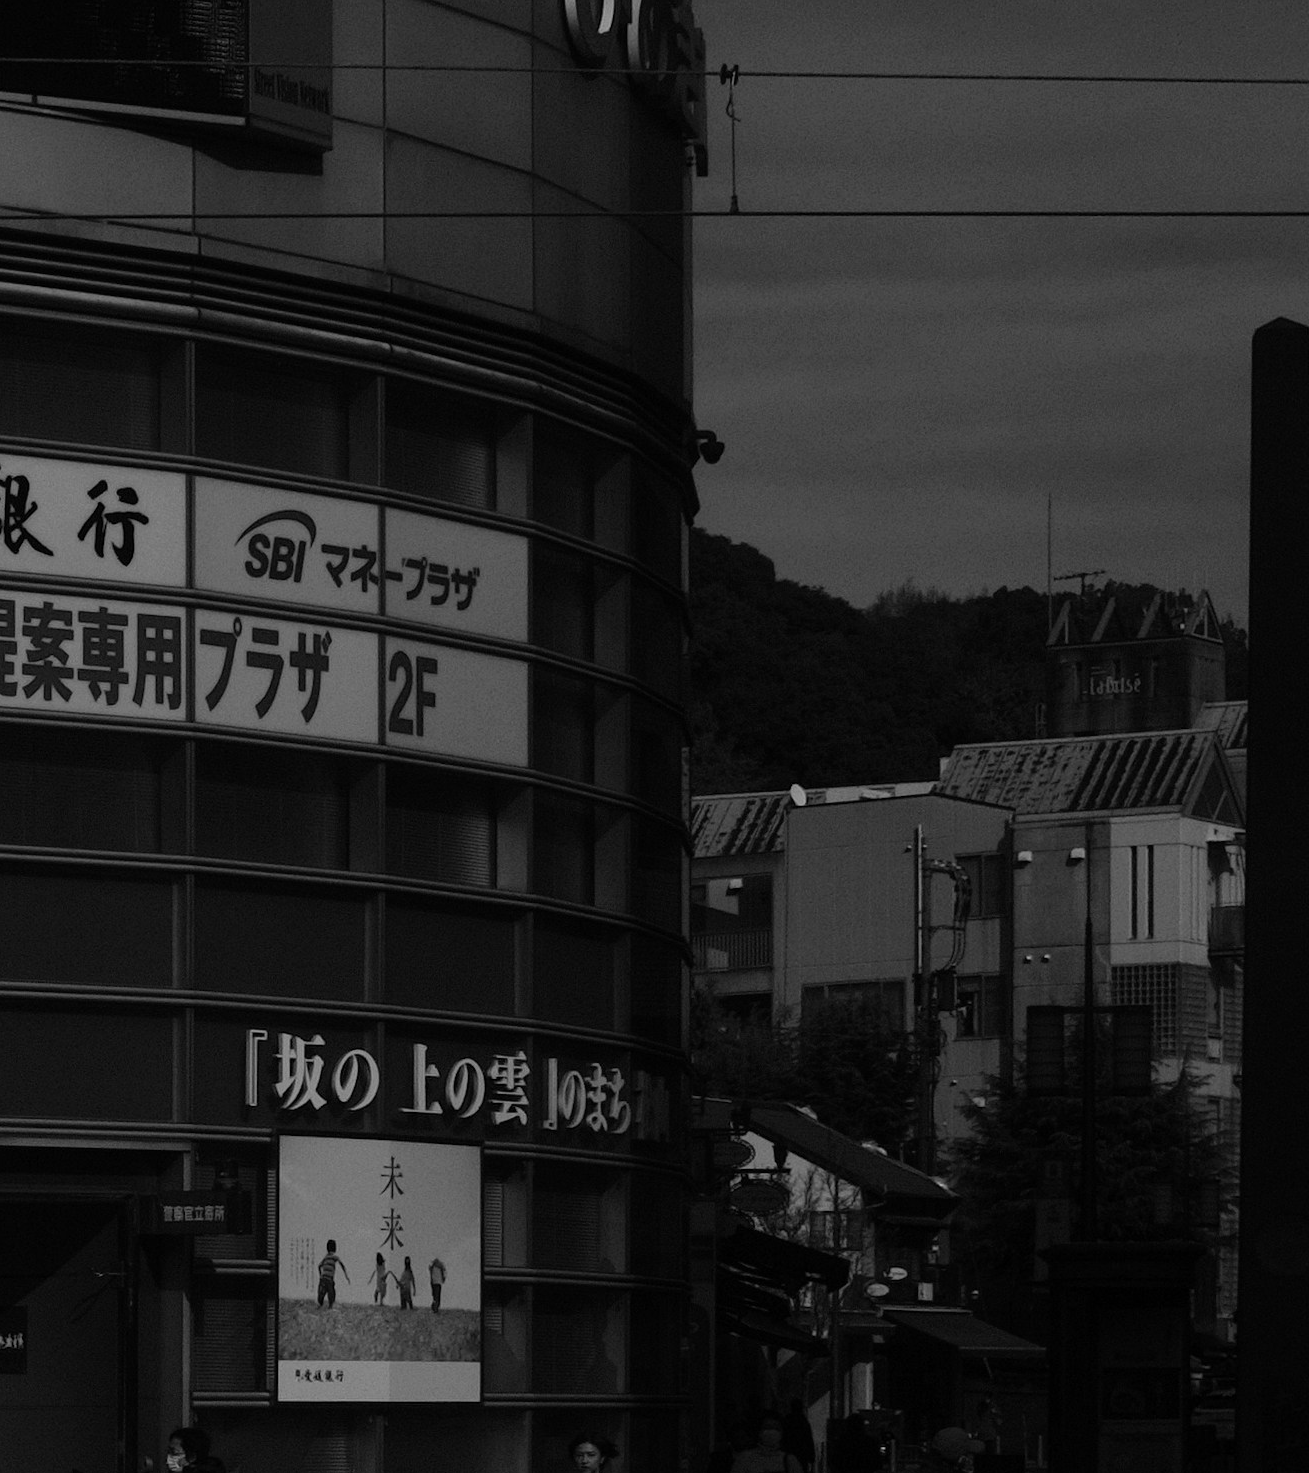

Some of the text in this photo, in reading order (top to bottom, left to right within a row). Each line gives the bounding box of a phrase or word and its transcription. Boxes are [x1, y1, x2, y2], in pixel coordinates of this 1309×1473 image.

[242, 533, 482, 612] SBI マネープラザ
[387, 651, 438, 738] 2F
[379, 1155, 405, 1251] 未来
